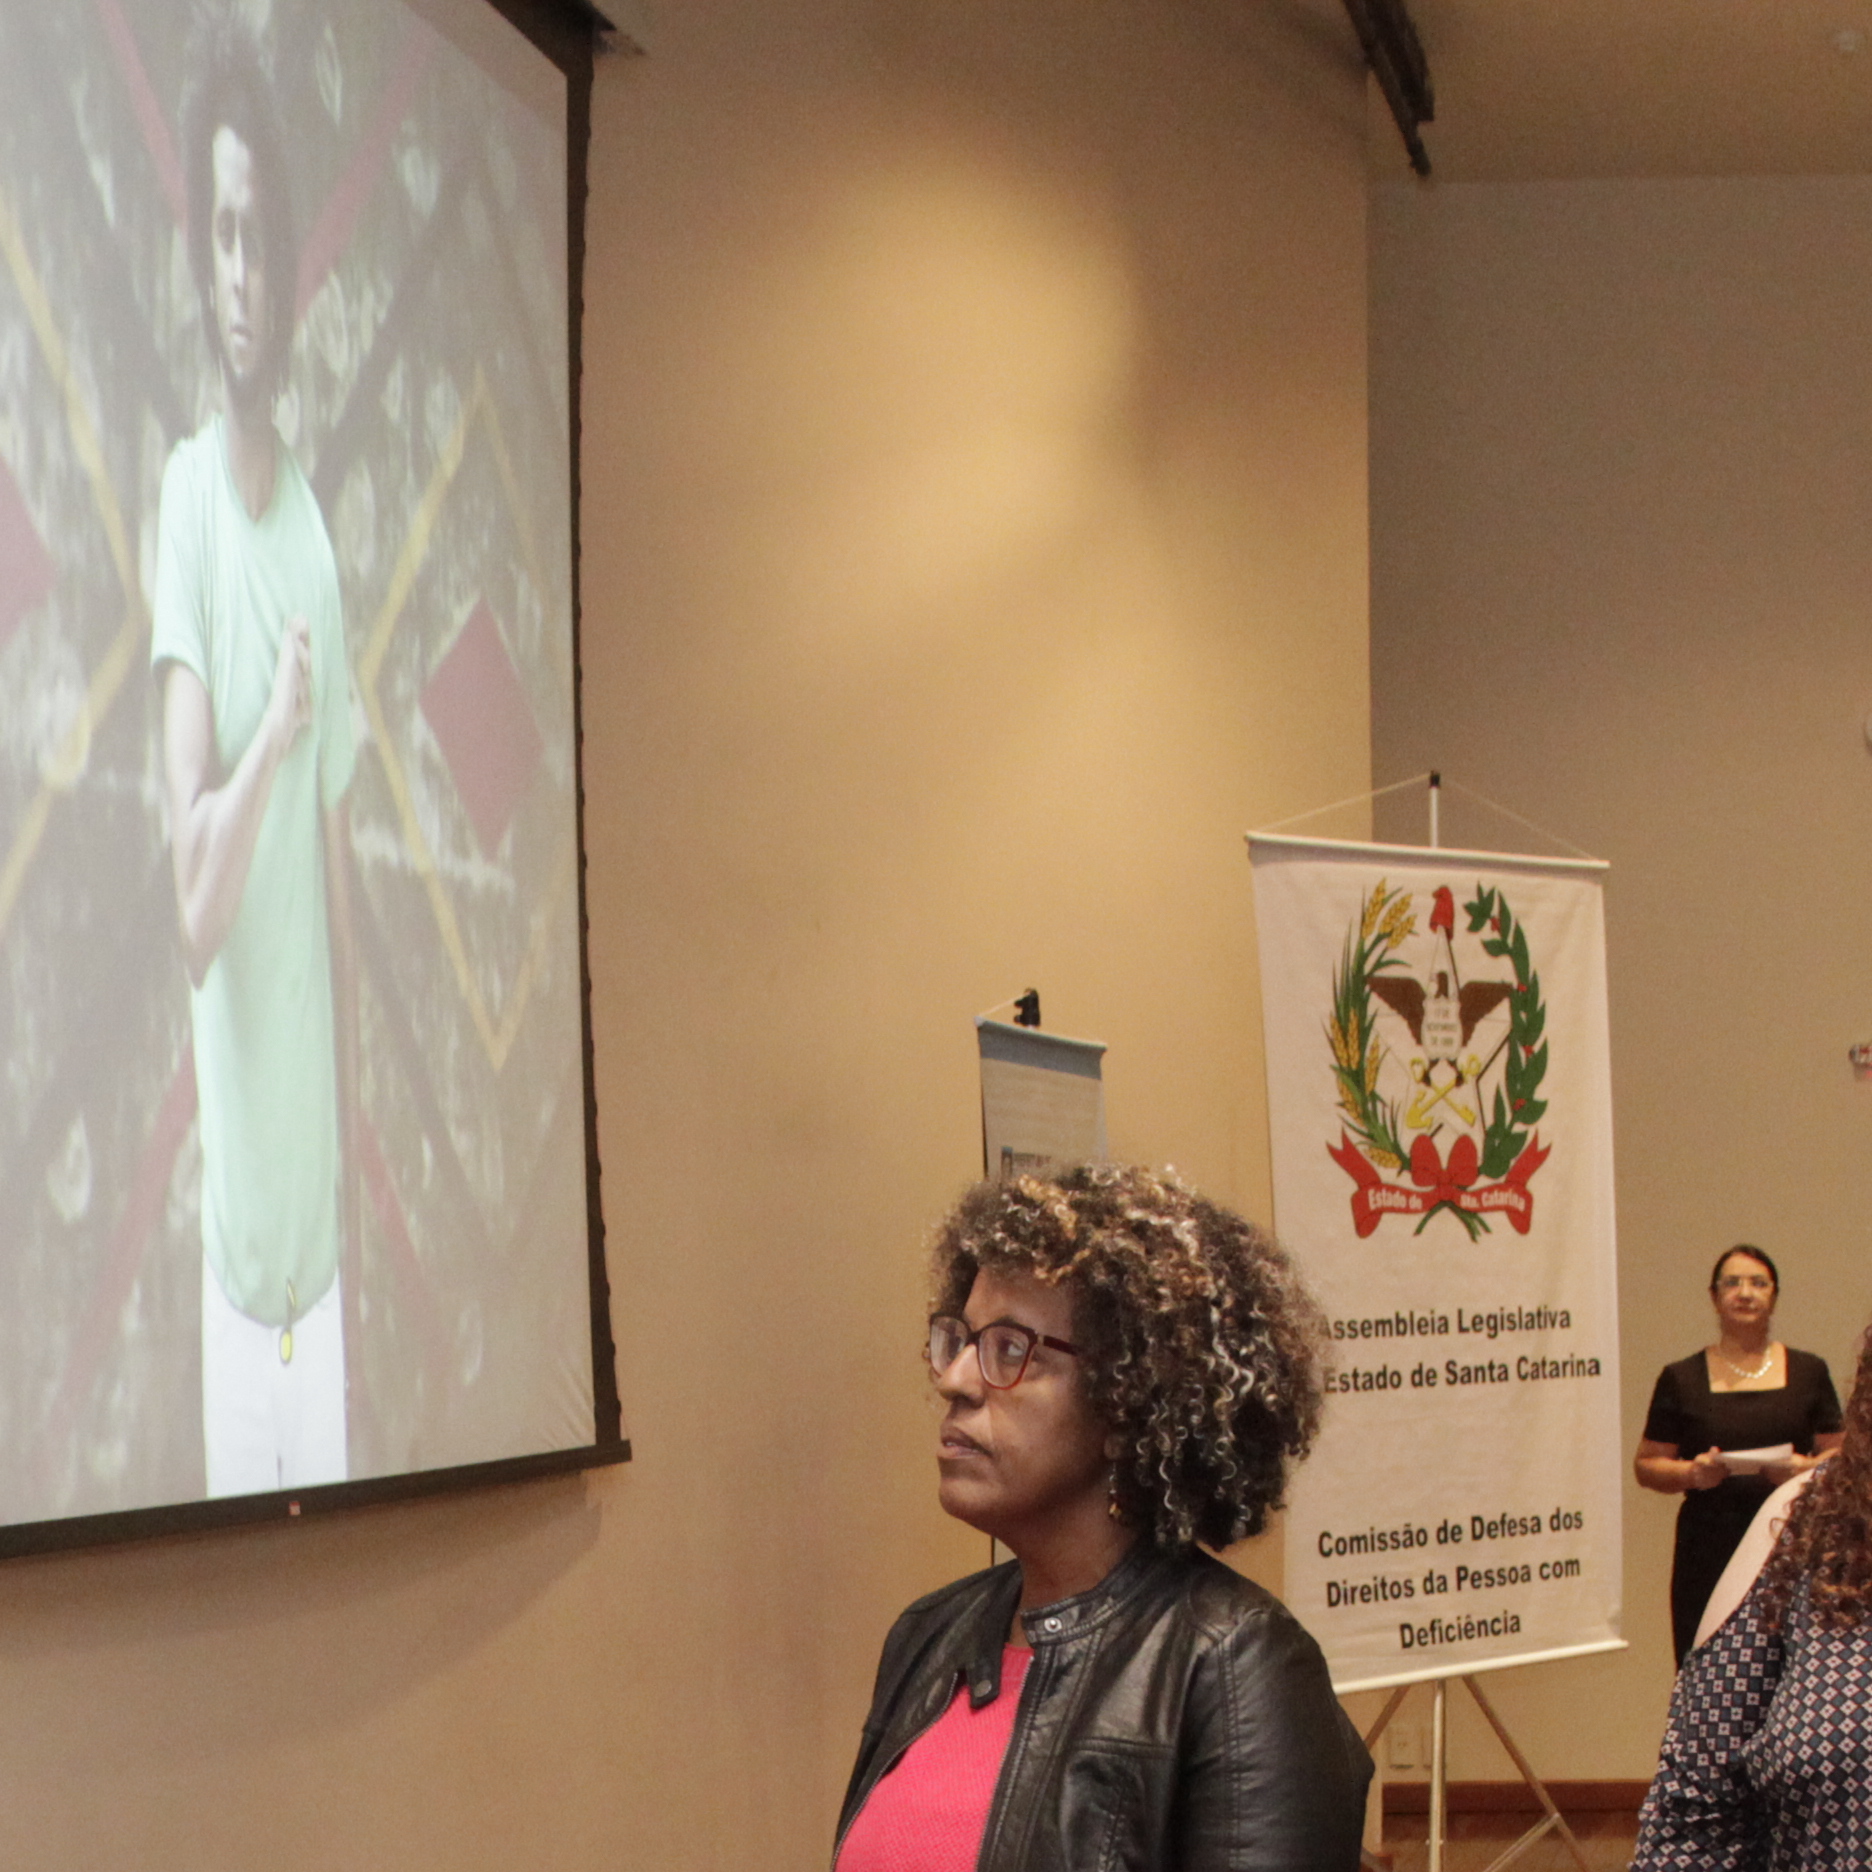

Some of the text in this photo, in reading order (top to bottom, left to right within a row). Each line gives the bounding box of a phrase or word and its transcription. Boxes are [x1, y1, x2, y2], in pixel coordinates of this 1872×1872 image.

[1368, 1188, 1406, 1211] Estado
[1481, 1188, 1526, 1212] Catarina
[1457, 1304, 1571, 1339] Legislativa
[1323, 1353, 1602, 1394] Estado de Santa Catarina
[1318, 1506, 1584, 1558] Comissão de Defesa dos
[1327, 1557, 1581, 1608] Direitos da Pessoa com
[1399, 1609, 1521, 1650] Deficiência
